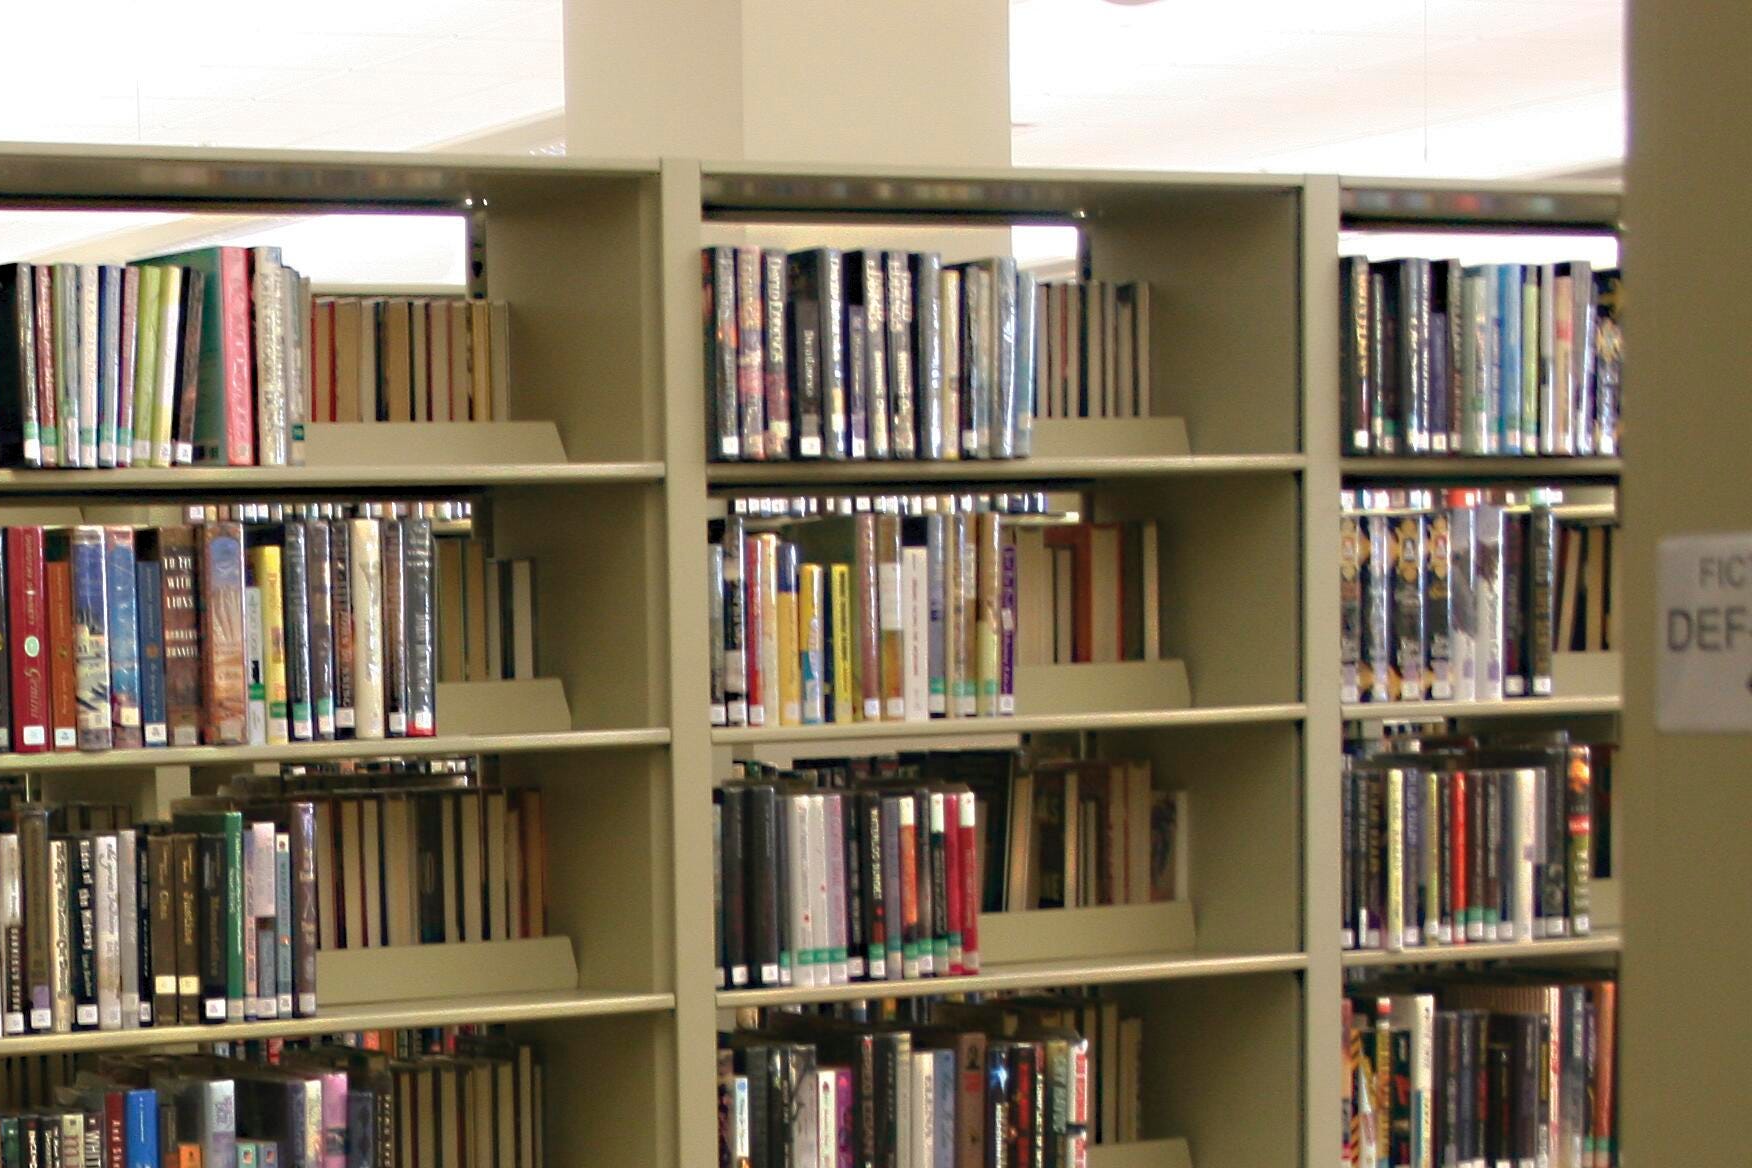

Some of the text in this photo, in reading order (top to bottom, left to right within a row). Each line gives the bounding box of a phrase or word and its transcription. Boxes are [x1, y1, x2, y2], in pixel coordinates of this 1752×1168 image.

[1699, 555, 1752, 588] FIC
[1667, 606, 1752, 652] DEF
[24, 668, 45, 720] Gemini
